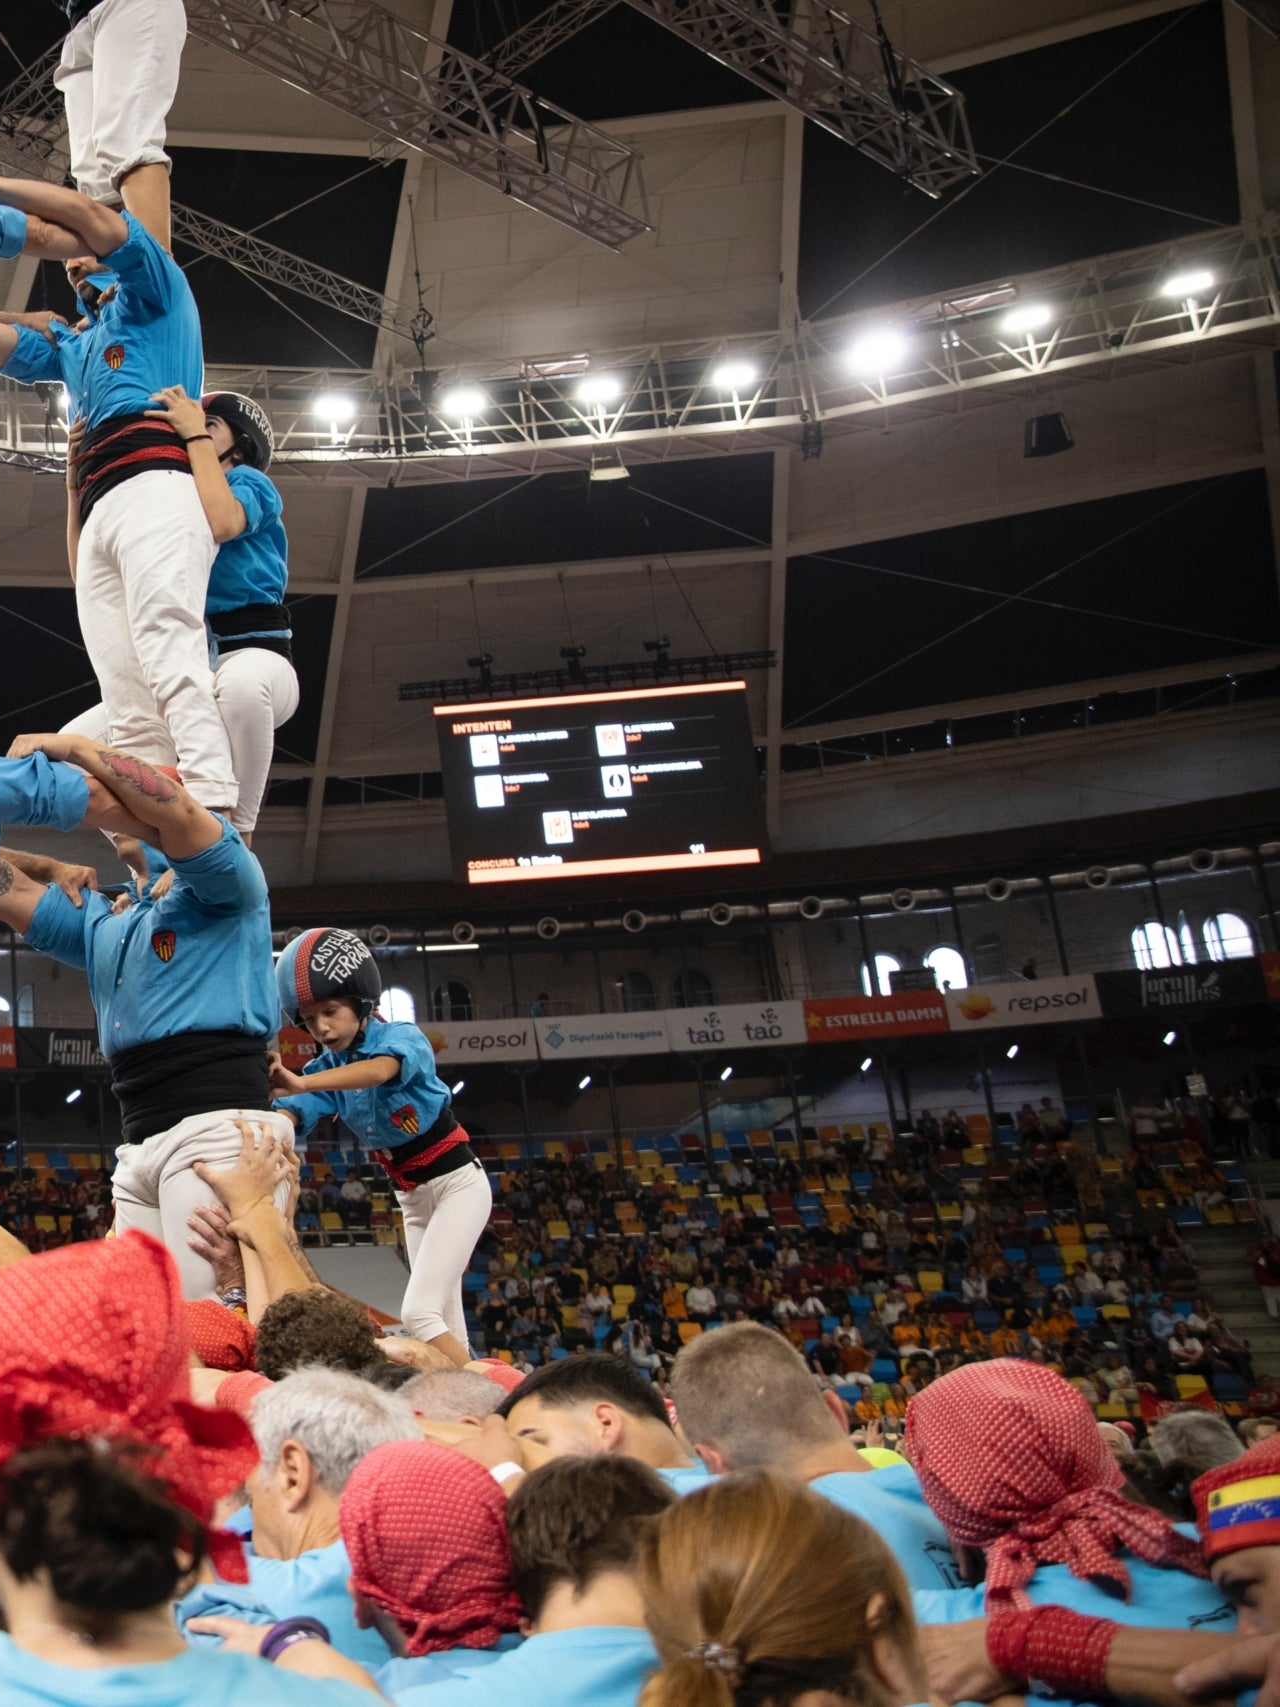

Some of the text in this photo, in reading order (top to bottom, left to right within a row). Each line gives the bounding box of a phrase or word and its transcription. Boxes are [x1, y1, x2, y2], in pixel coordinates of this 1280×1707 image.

[452, 720, 512, 735] INTENTEN
[468, 858, 515, 870] CONCURS
[340, 943, 353, 952] DE
[1007, 987, 1087, 1013] repsol
[826, 1006, 943, 1028] ESTRELLA DAMM
[458, 1031, 527, 1051] repsol
[569, 1029, 663, 1043] Diputació Tarragona
